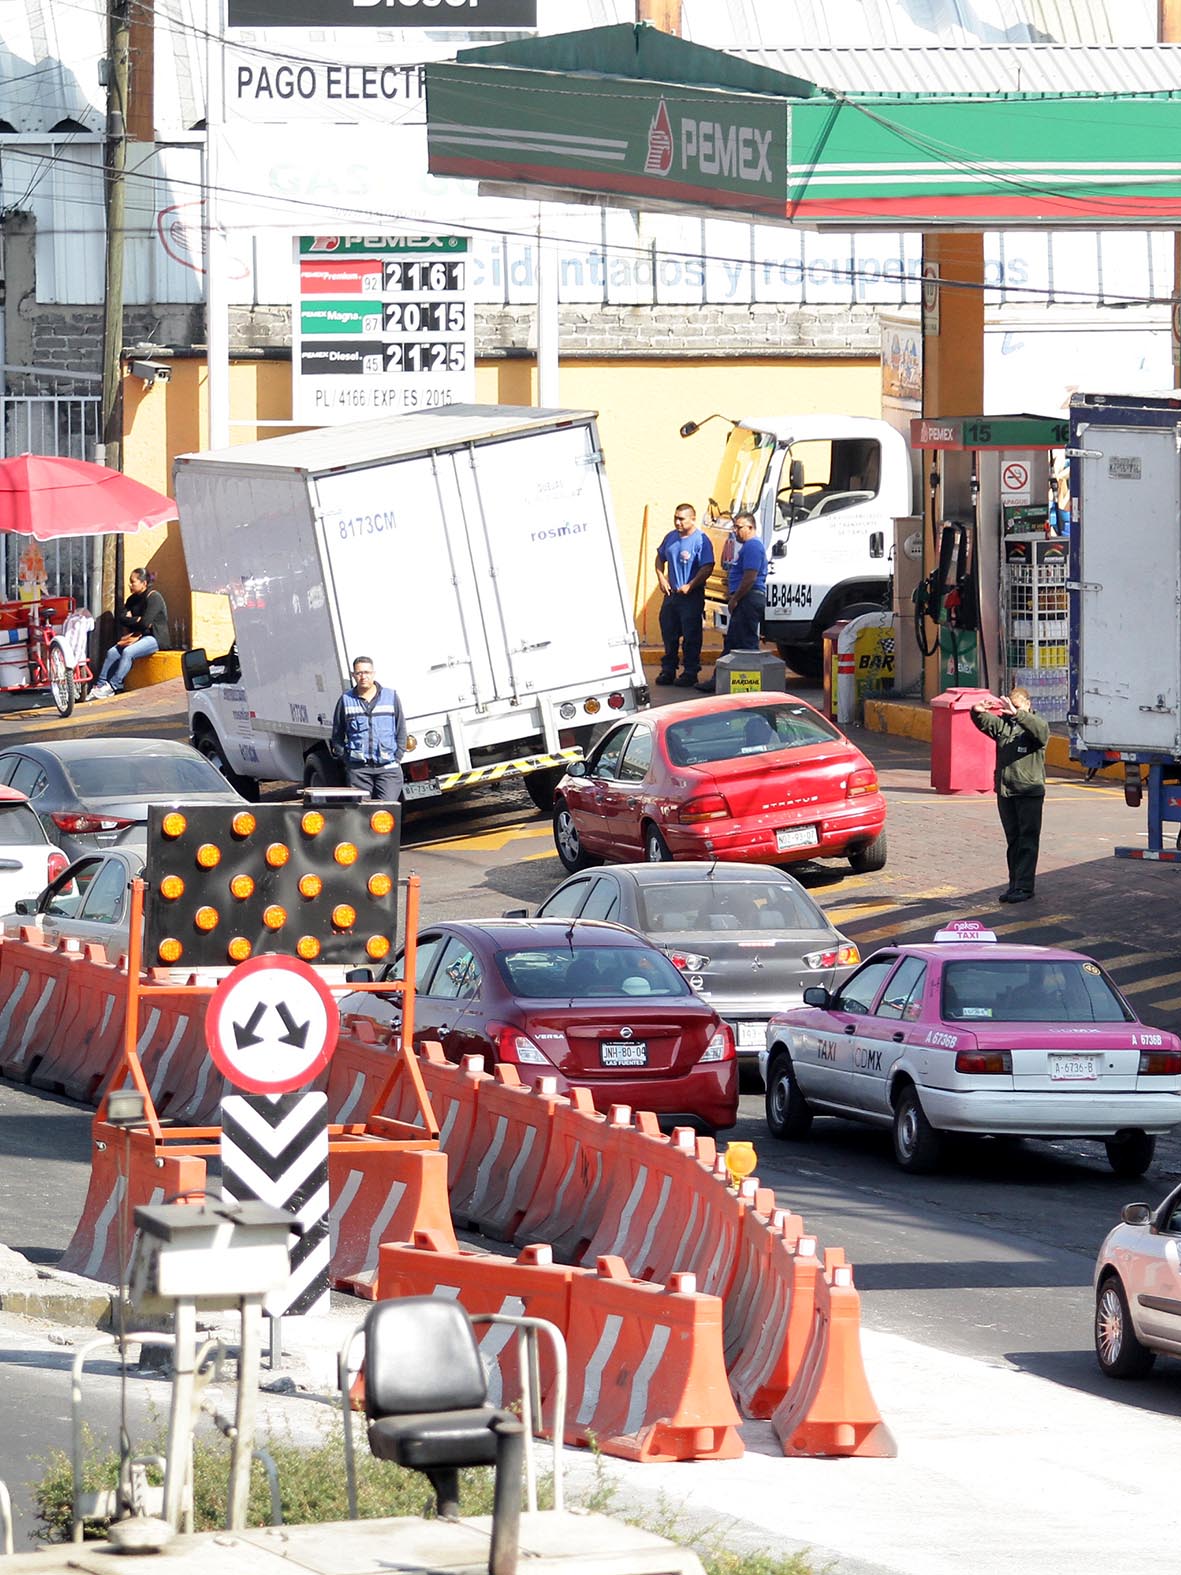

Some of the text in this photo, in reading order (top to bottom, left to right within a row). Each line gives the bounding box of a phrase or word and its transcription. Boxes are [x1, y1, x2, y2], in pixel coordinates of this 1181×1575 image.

[237, 65, 317, 99] PAGO
[681, 117, 773, 183] PEMEX
[364, 277, 378, 291] 92
[386, 262, 465, 291] 21.61
[386, 303, 465, 332] 20.15
[329, 351, 359, 362] Diesel
[366, 358, 379, 372] 45
[386, 343, 466, 372] 21.25
[928, 427, 954, 442] PEMEX
[969, 424, 992, 443] 15
[338, 510, 398, 541] 8173CM
[530, 520, 589, 543] rosmar
[956, 931, 980, 940] TAXI
[925, 1030, 958, 1049] A 6736B
[1131, 1033, 1162, 1046] A 6736B
[817, 1039, 837, 1062] TAXI
[855, 1047, 883, 1072] CDMX
[618, 1059, 644, 1067] FUENTES
[1055, 1062, 1094, 1074] A-6736-B
